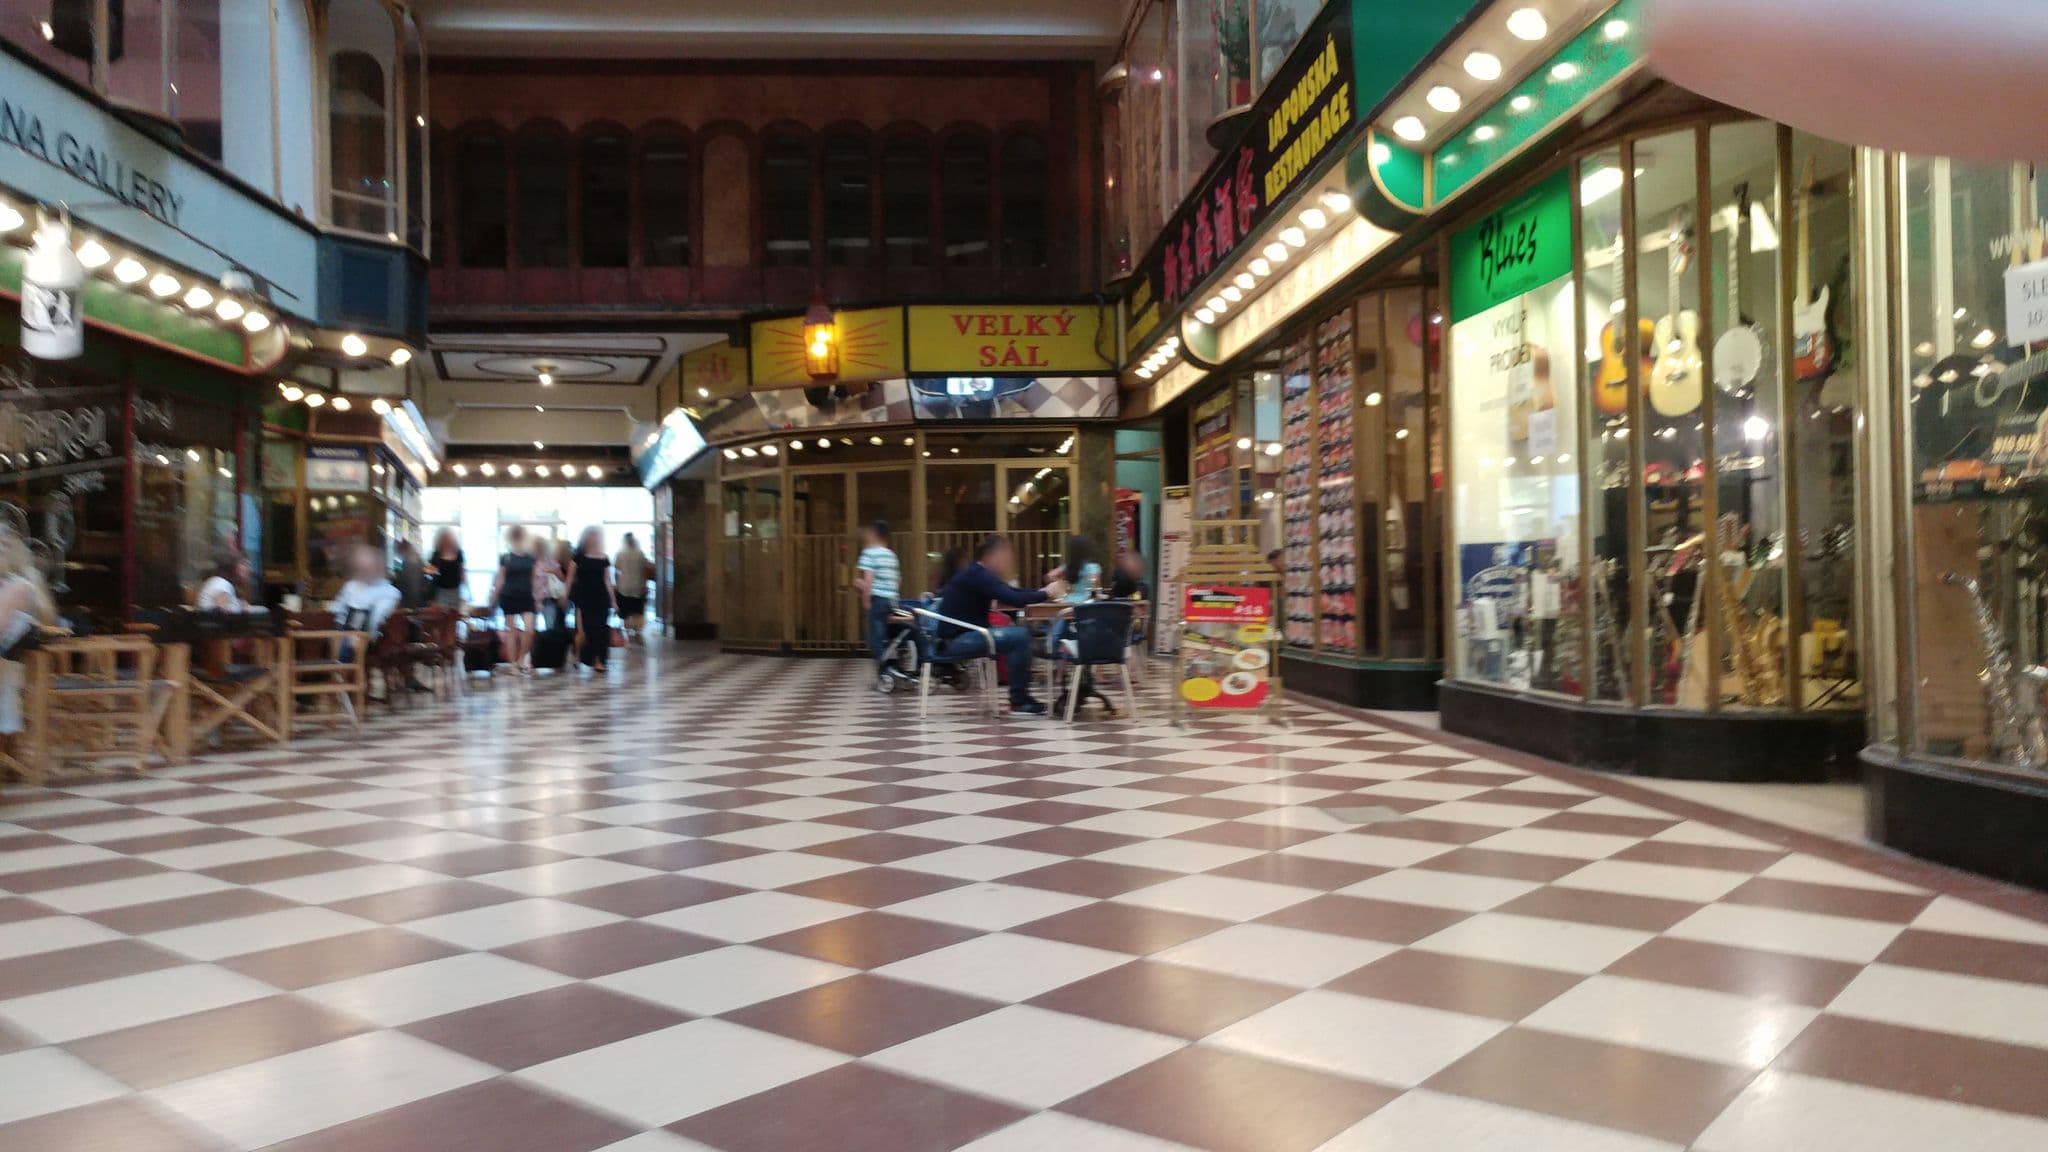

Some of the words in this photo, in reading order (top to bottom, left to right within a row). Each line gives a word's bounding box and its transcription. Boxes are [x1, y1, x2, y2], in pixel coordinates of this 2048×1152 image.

[1268, 31, 1339, 152] JAPONSKÁ
[57, 130, 183, 225] GALLERY
[1264, 82, 1350, 207] RESTAURACE
[1479, 211, 1538, 293] Blues
[950, 308, 1076, 336] VELKÝ
[979, 339, 1048, 367] SÁL
